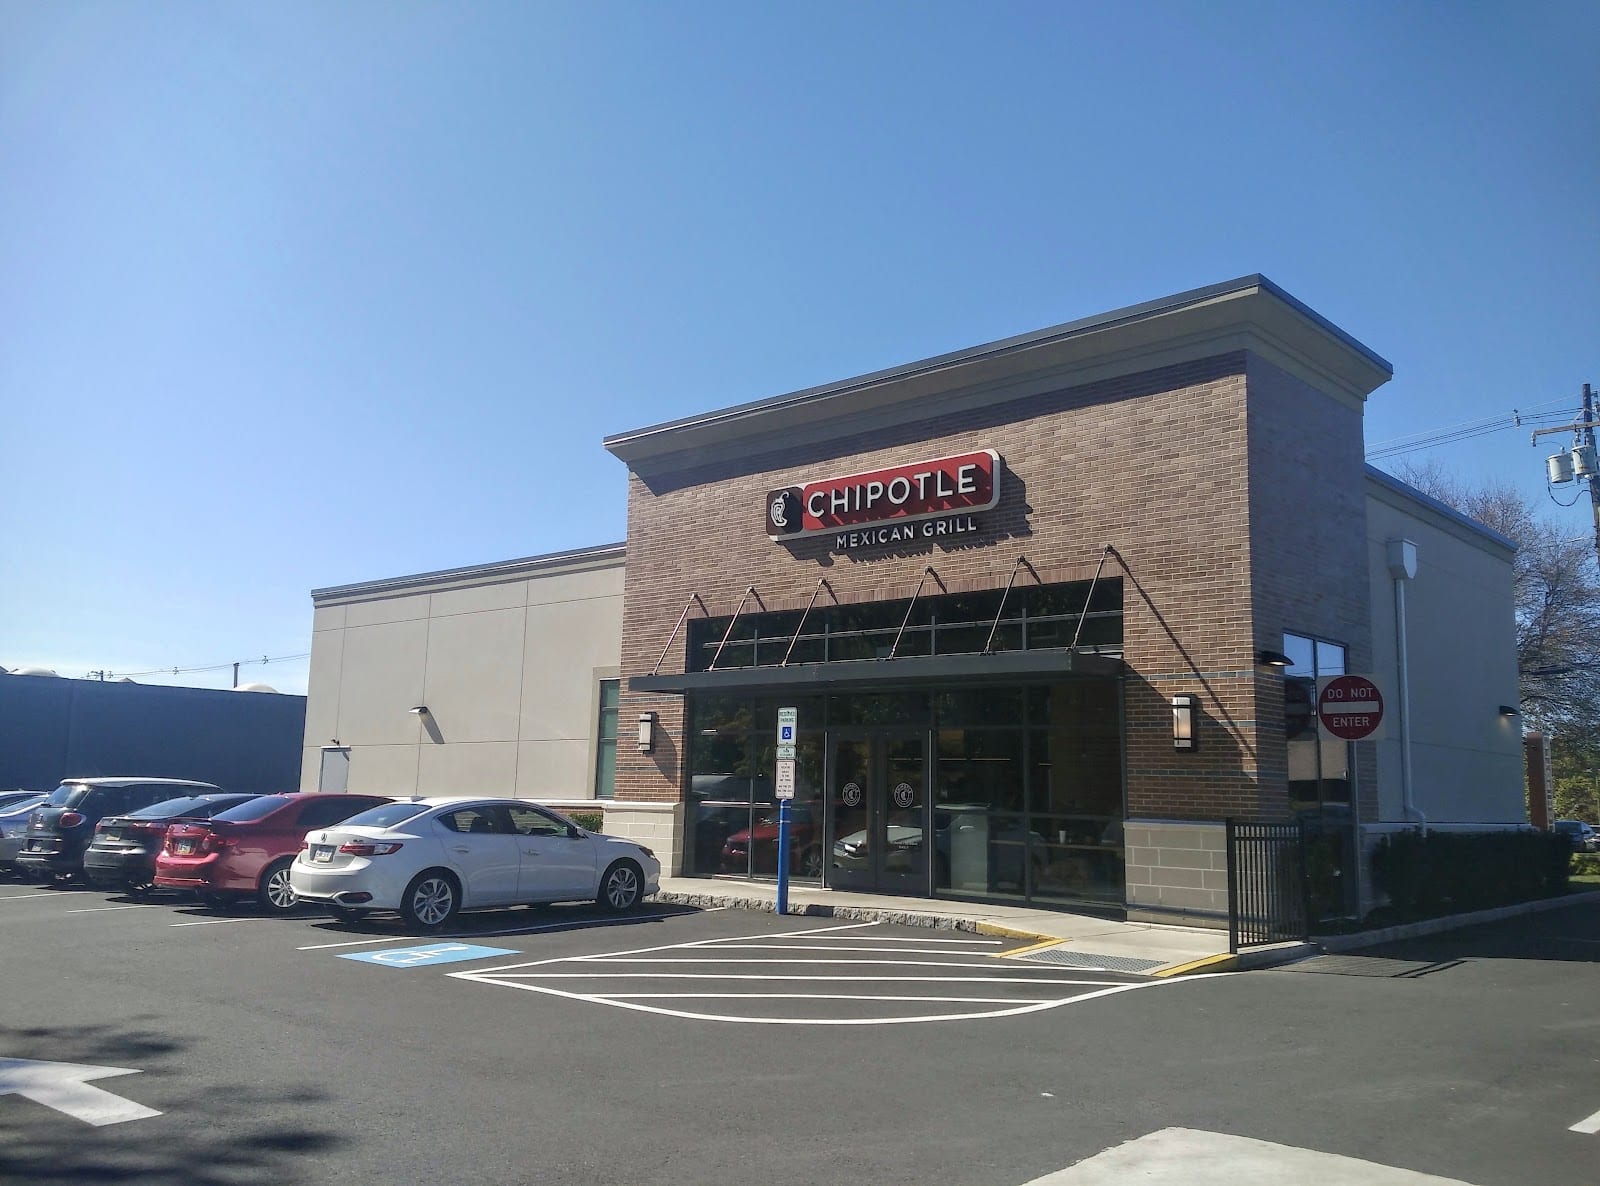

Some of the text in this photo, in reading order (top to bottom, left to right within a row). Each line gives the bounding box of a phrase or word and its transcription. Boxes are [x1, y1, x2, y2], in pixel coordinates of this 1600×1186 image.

[807, 463, 977, 518] CHIPOTLE
[836, 516, 977, 549] MEXICAN GRILL
[1327, 687, 1374, 699] DO NOT
[1333, 716, 1370, 728] ENTER
